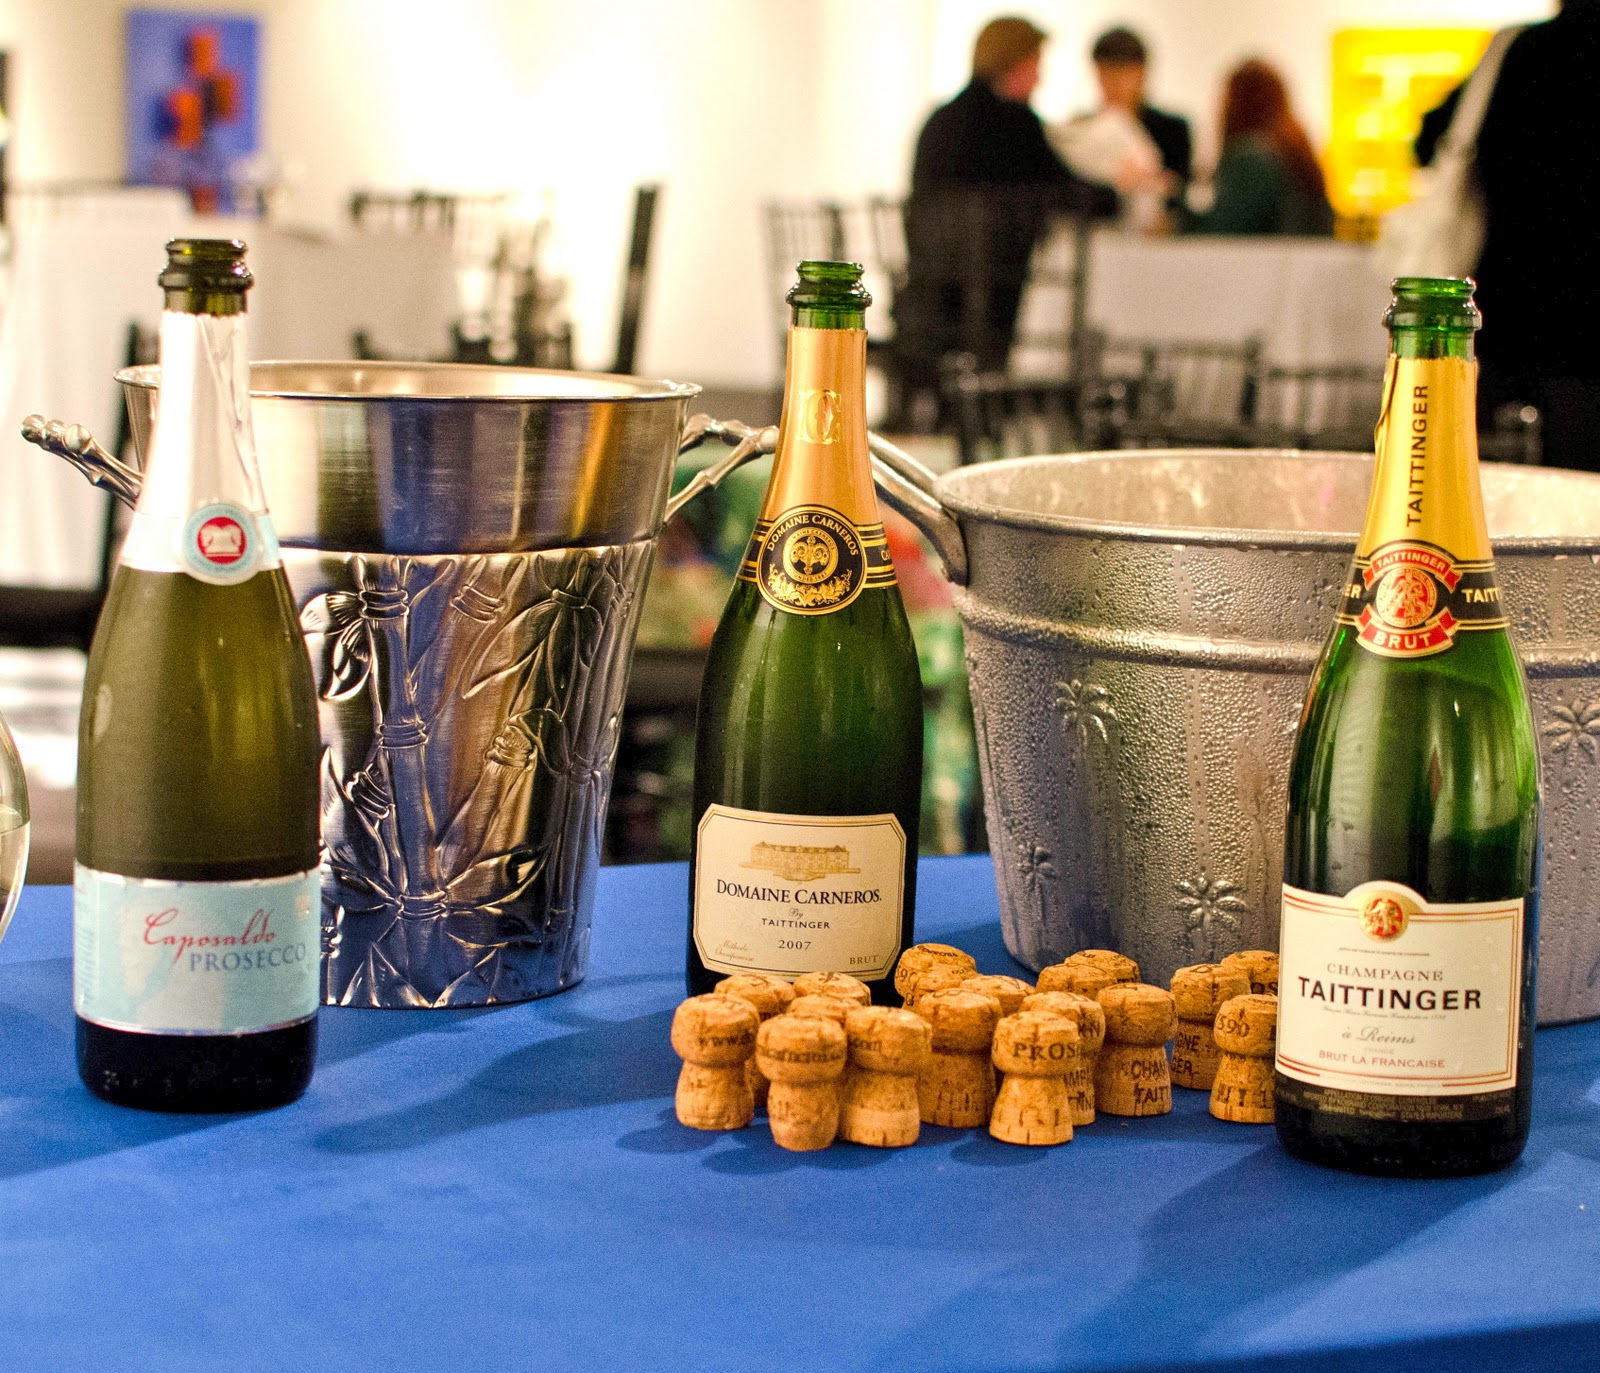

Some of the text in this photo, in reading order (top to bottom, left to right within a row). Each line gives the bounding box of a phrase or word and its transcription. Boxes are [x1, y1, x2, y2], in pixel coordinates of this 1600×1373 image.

[1406, 385, 1429, 528] TAITTINGER
[766, 514, 859, 556] DOMAINE CARNEROS
[1375, 551, 1446, 572] TAITTINGER
[1373, 630, 1431, 649] BRUT
[716, 879, 790, 904] DOMAINE
[788, 907, 804, 918] By
[761, 917, 830, 930] TAITTINGER
[143, 908, 277, 965] Caposaldo
[777, 939, 812, 951] 2007
[189, 943, 307, 973] PROSECCO
[849, 954, 879, 966] BRUT
[1326, 962, 1444, 982] CHAMPAGNE
[1298, 976, 1482, 1011] TAITTINGER
[1356, 1025, 1416, 1044] Reims
[1013, 1042, 1080, 1061] PROS
[1318, 1050, 1348, 1062] BRUT
[1351, 1055, 1367, 1065] LA
